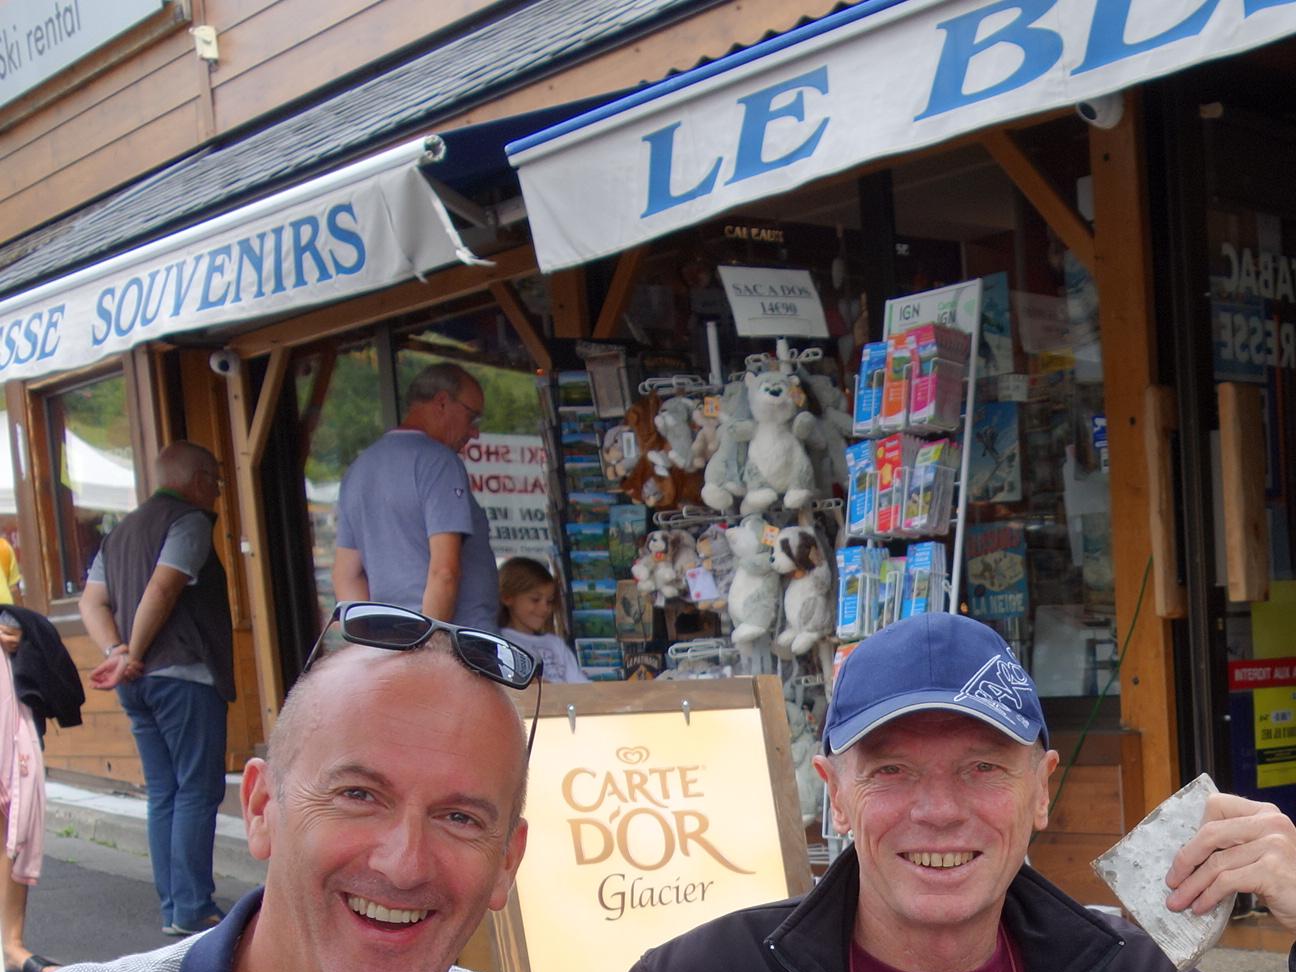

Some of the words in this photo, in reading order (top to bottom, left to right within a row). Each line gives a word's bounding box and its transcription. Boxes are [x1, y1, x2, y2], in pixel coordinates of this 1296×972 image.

[26, 0, 81, 61] rental
[640, 65, 830, 220] LE
[0, 303, 66, 372] SSE
[91, 201, 367, 346] SOUVENIRS
[900, 304, 920, 321] IGN
[1234, 668, 1272, 682] INTERDIT
[1273, 667, 1291, 679] AUX
[561, 765, 705, 813] CARTE
[566, 806, 756, 875] D'OR
[598, 873, 714, 921] Glacier
